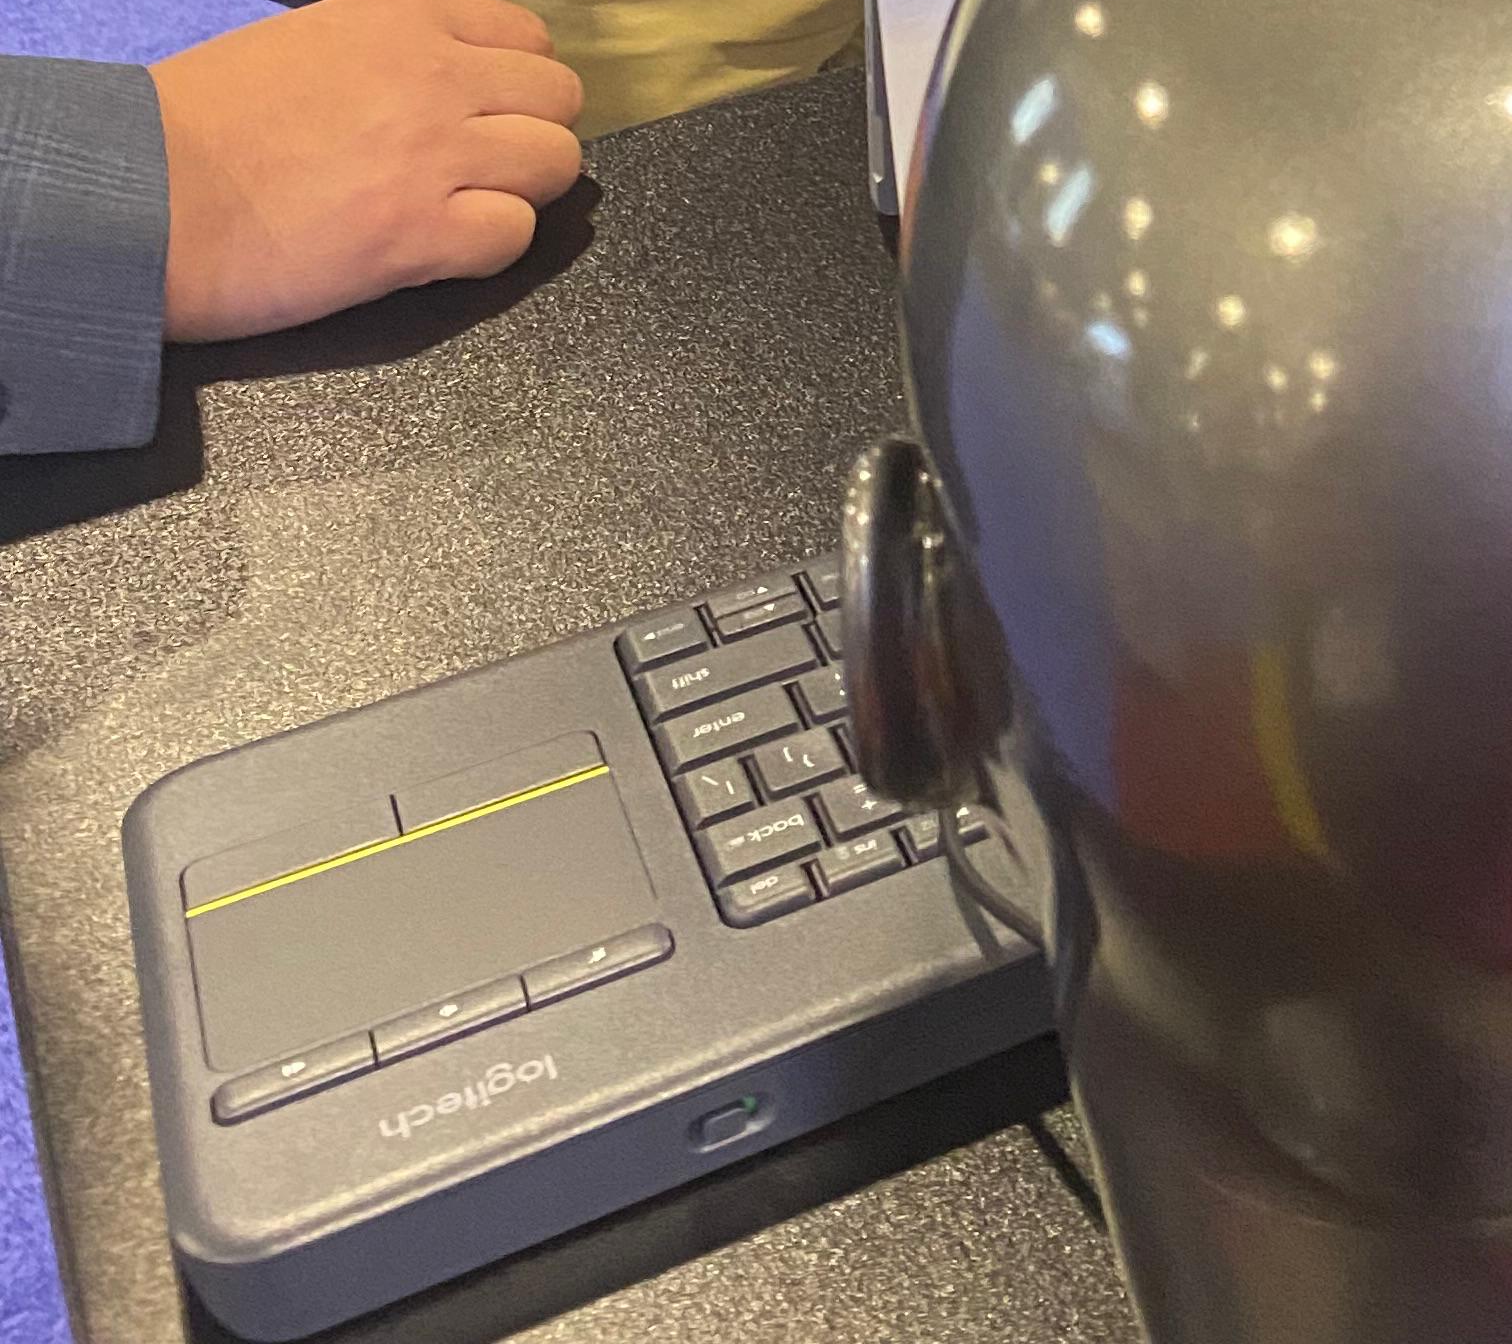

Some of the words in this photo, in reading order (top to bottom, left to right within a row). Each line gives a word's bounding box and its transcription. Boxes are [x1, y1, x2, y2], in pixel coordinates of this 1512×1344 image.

[672, 667, 710, 690] shift
[693, 712, 745, 739] enter
[747, 813, 804, 843] back
[378, 1054, 558, 1138] logitech
